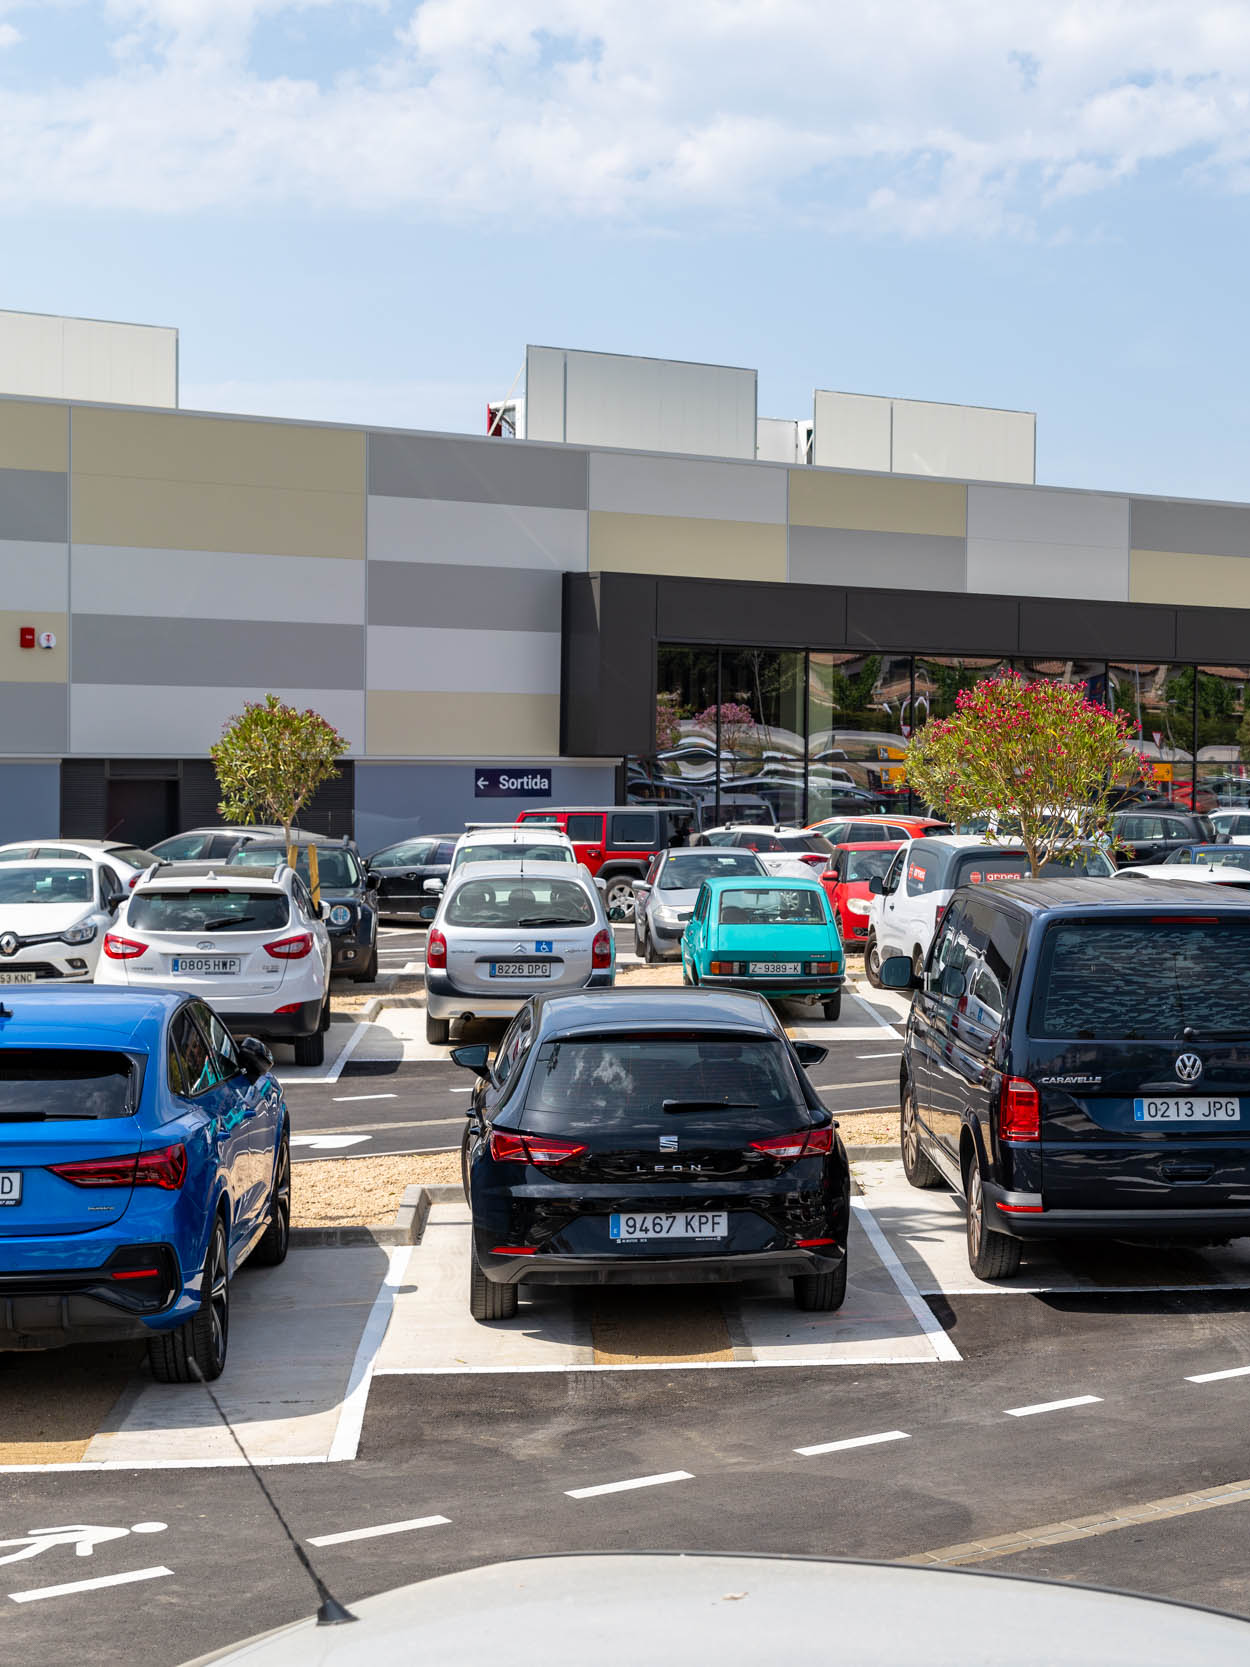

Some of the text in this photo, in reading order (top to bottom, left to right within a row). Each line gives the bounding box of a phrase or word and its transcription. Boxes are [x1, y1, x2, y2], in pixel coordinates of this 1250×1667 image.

[499, 775, 549, 789] Sortida
[180, 960, 236, 970] 0805 HWP
[498, 964, 548, 974] 8226 DPG
[1042, 1076, 1102, 1084] CARAVELLE
[1147, 1101, 1235, 1118] 0213 JPG
[625, 1215, 676, 1235] 9467
[685, 1214, 722, 1233] KPF
